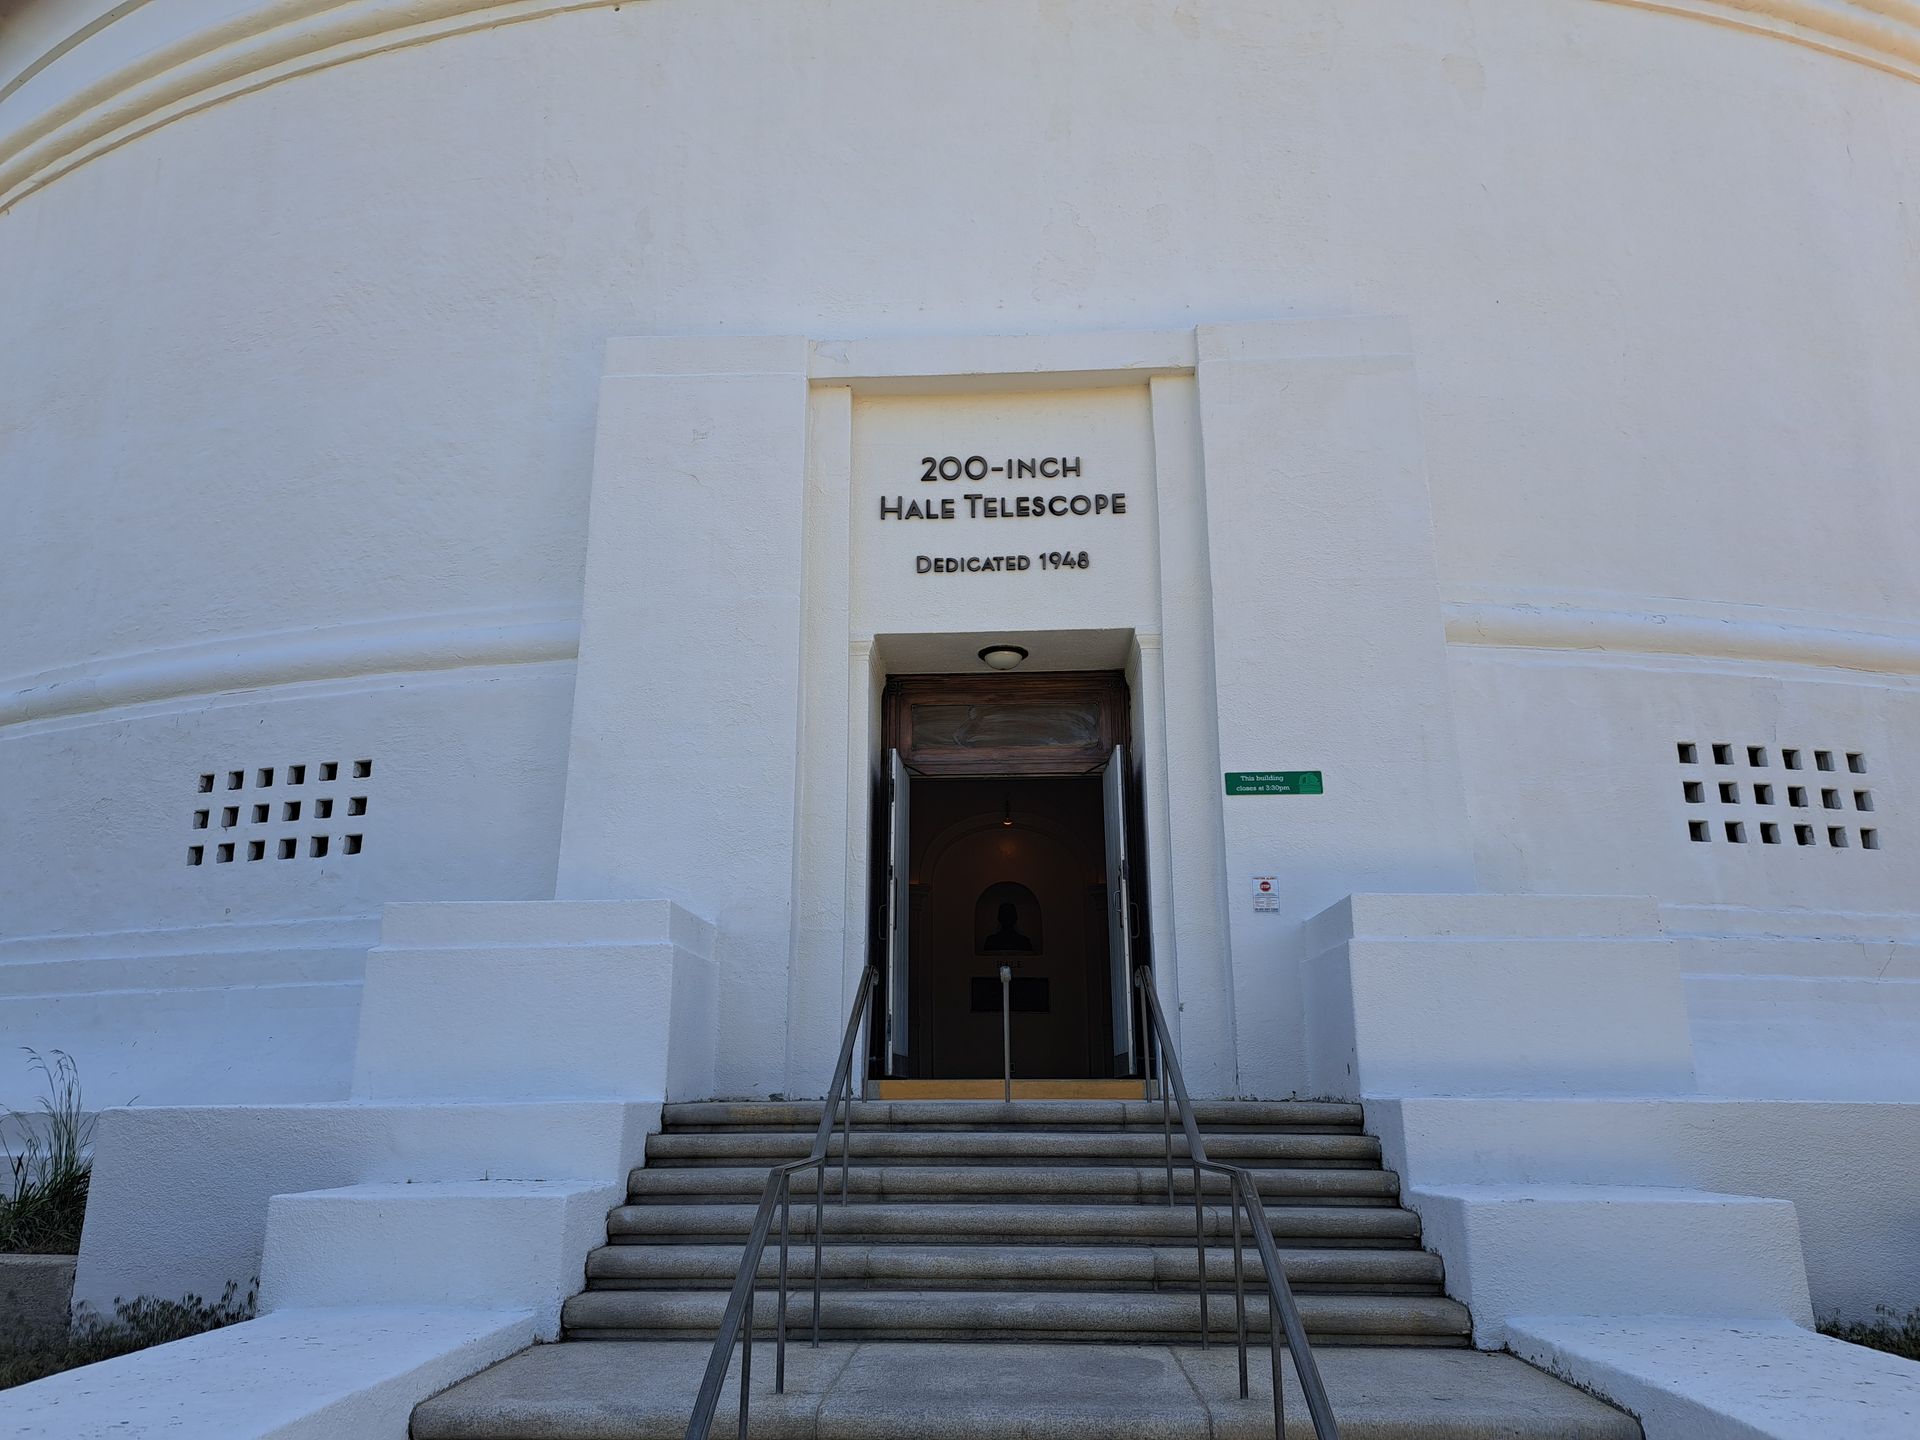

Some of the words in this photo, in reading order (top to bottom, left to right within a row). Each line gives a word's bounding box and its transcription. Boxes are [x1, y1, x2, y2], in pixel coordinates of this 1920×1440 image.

[920, 455, 1081, 482] 200-INCH
[880, 494, 955, 521] HALE
[963, 492, 1127, 519] TELESCOPE
[915, 554, 1031, 574] DEDICATED
[1038, 550, 1090, 571] 1948
